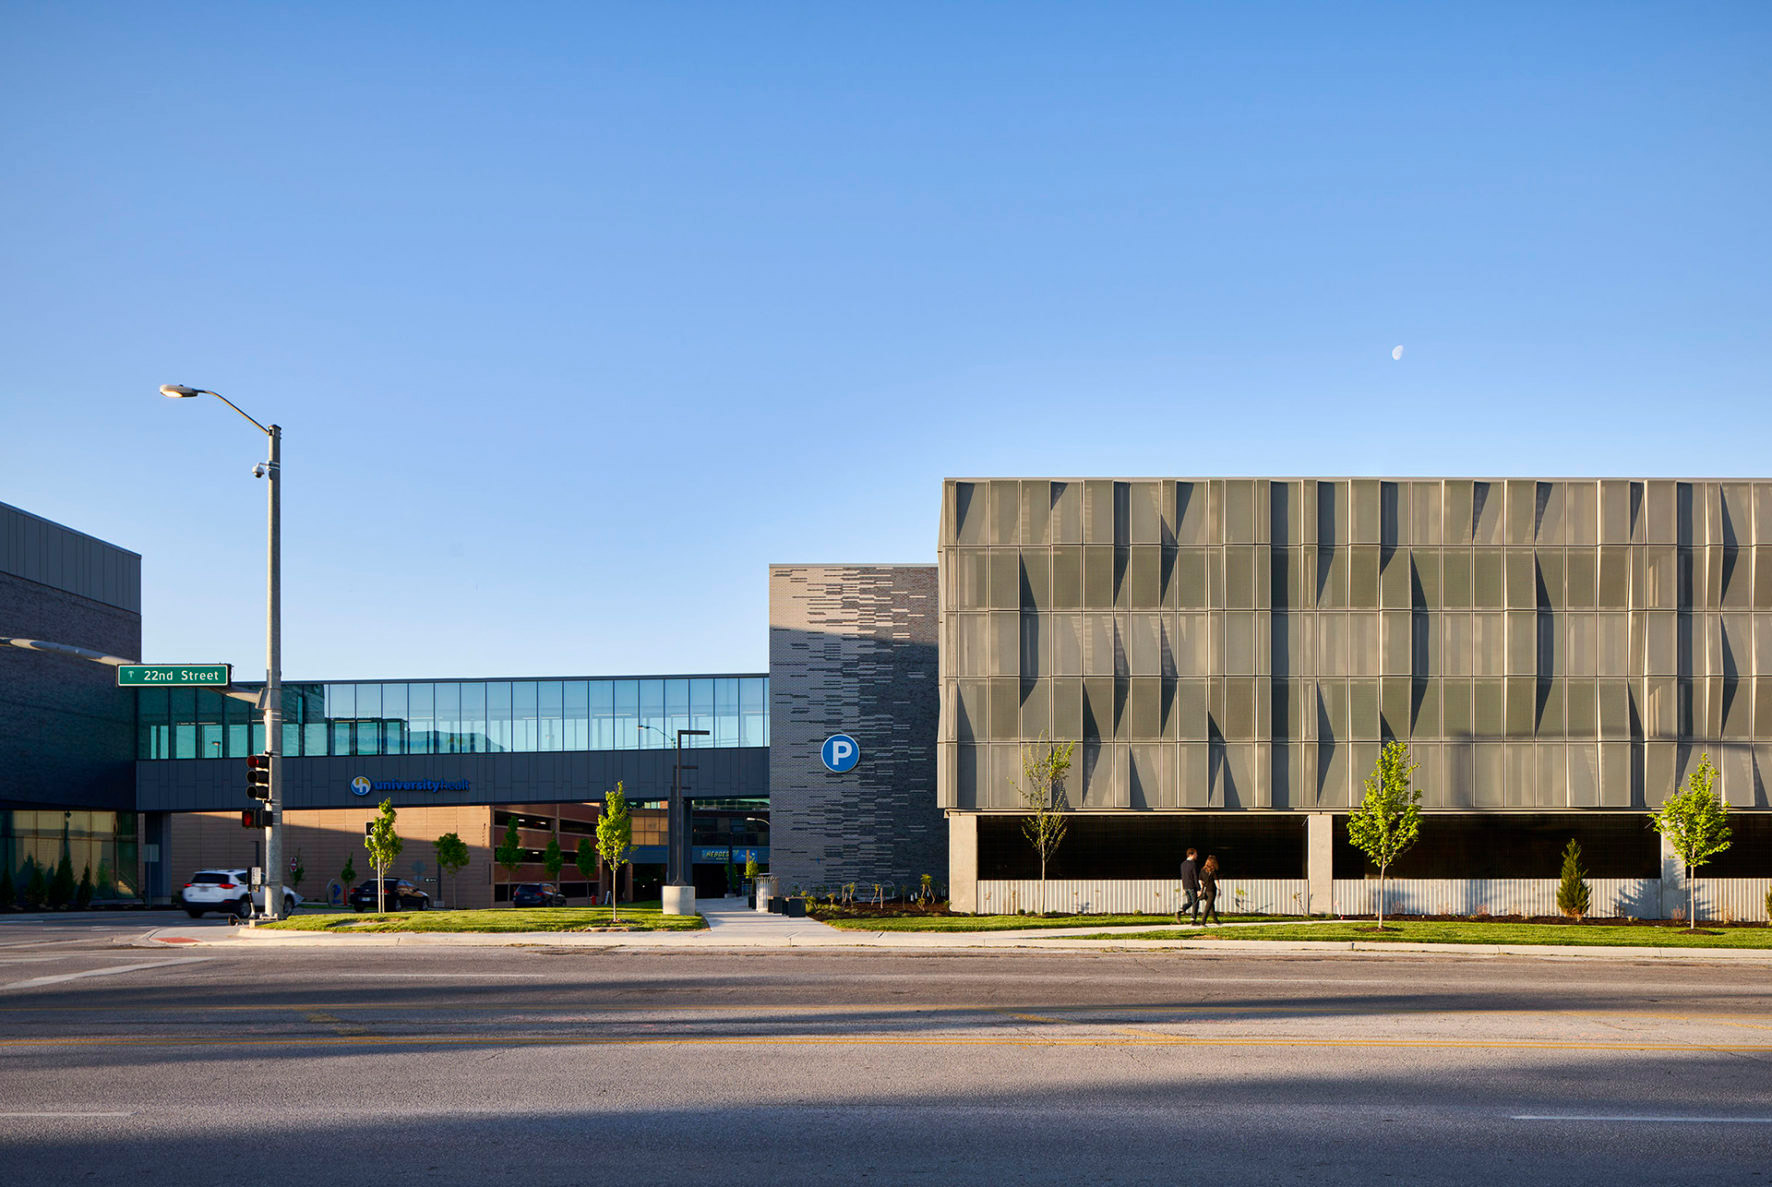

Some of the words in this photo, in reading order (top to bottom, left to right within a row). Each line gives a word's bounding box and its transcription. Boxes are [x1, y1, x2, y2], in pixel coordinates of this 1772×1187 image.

[144, 670, 173, 681] 22nd
[181, 670, 219, 681] Street
[832, 740, 853, 766] P
